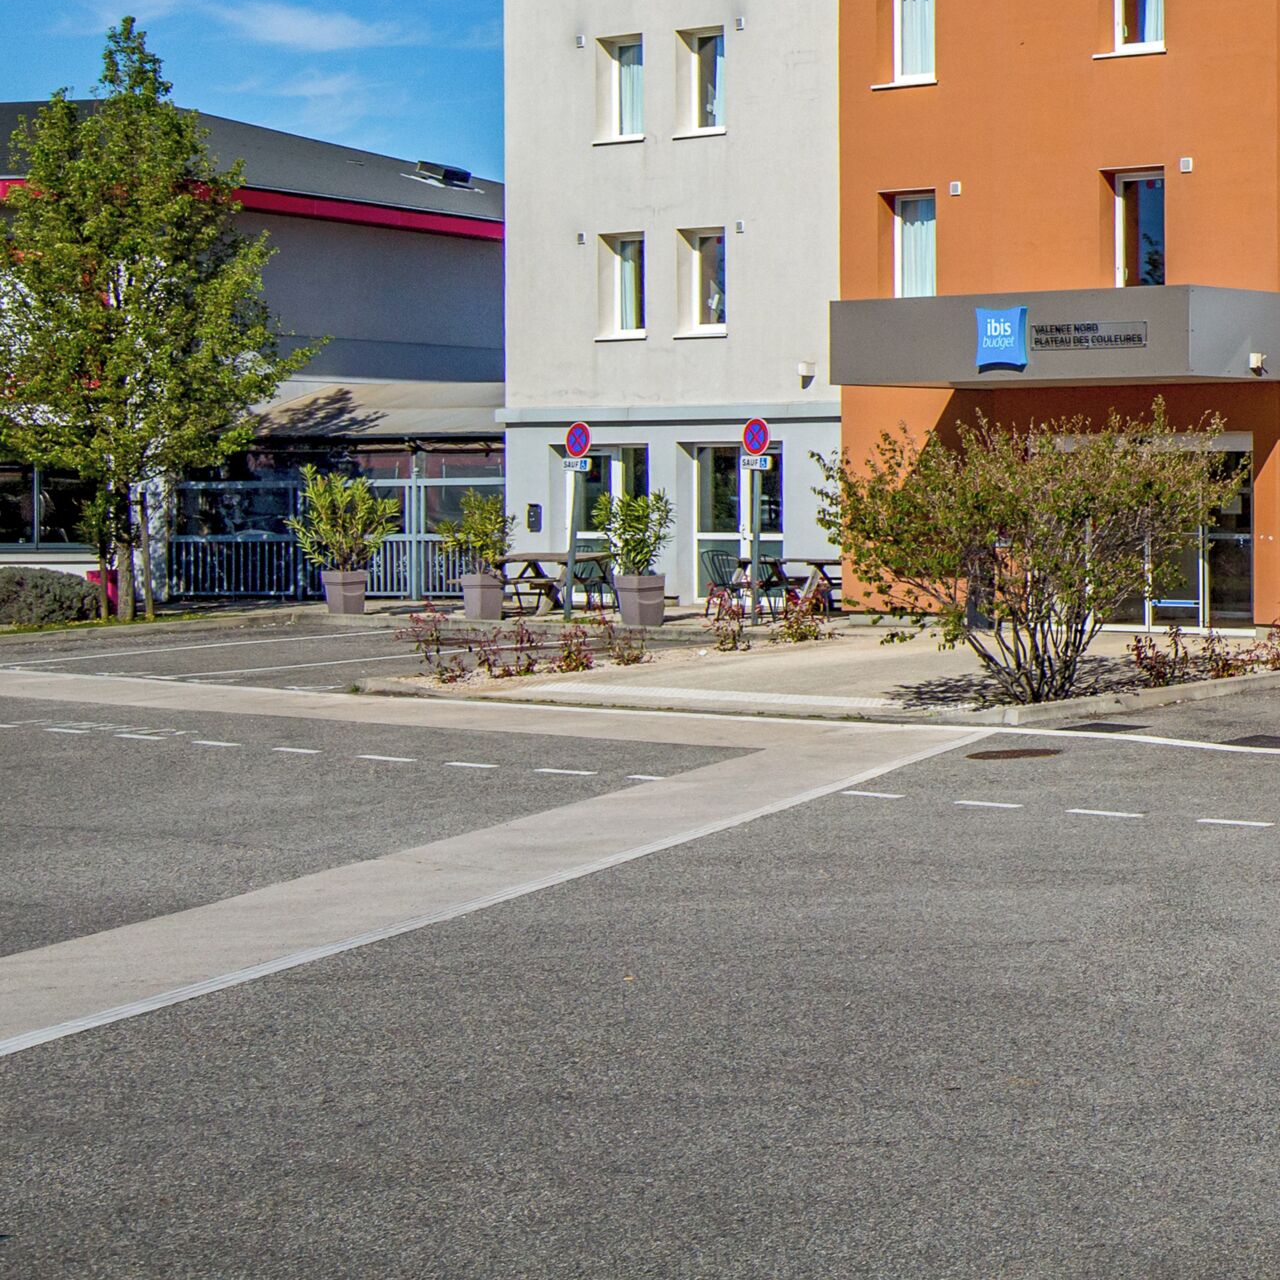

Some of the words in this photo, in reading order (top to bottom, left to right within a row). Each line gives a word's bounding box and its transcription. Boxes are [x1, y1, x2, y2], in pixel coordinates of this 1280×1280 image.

[987, 318, 1012, 336] ibis
[1033, 324, 1072, 335] VALENCE
[1073, 323, 1099, 333] NORD
[982, 336, 1015, 350] budget
[1034, 336, 1071, 346] PLATEAU
[1073, 335, 1089, 345] DES
[1091, 334, 1143, 344] COULEURES
[563, 460, 579, 468] SAUF
[742, 458, 758, 466] SAUF
